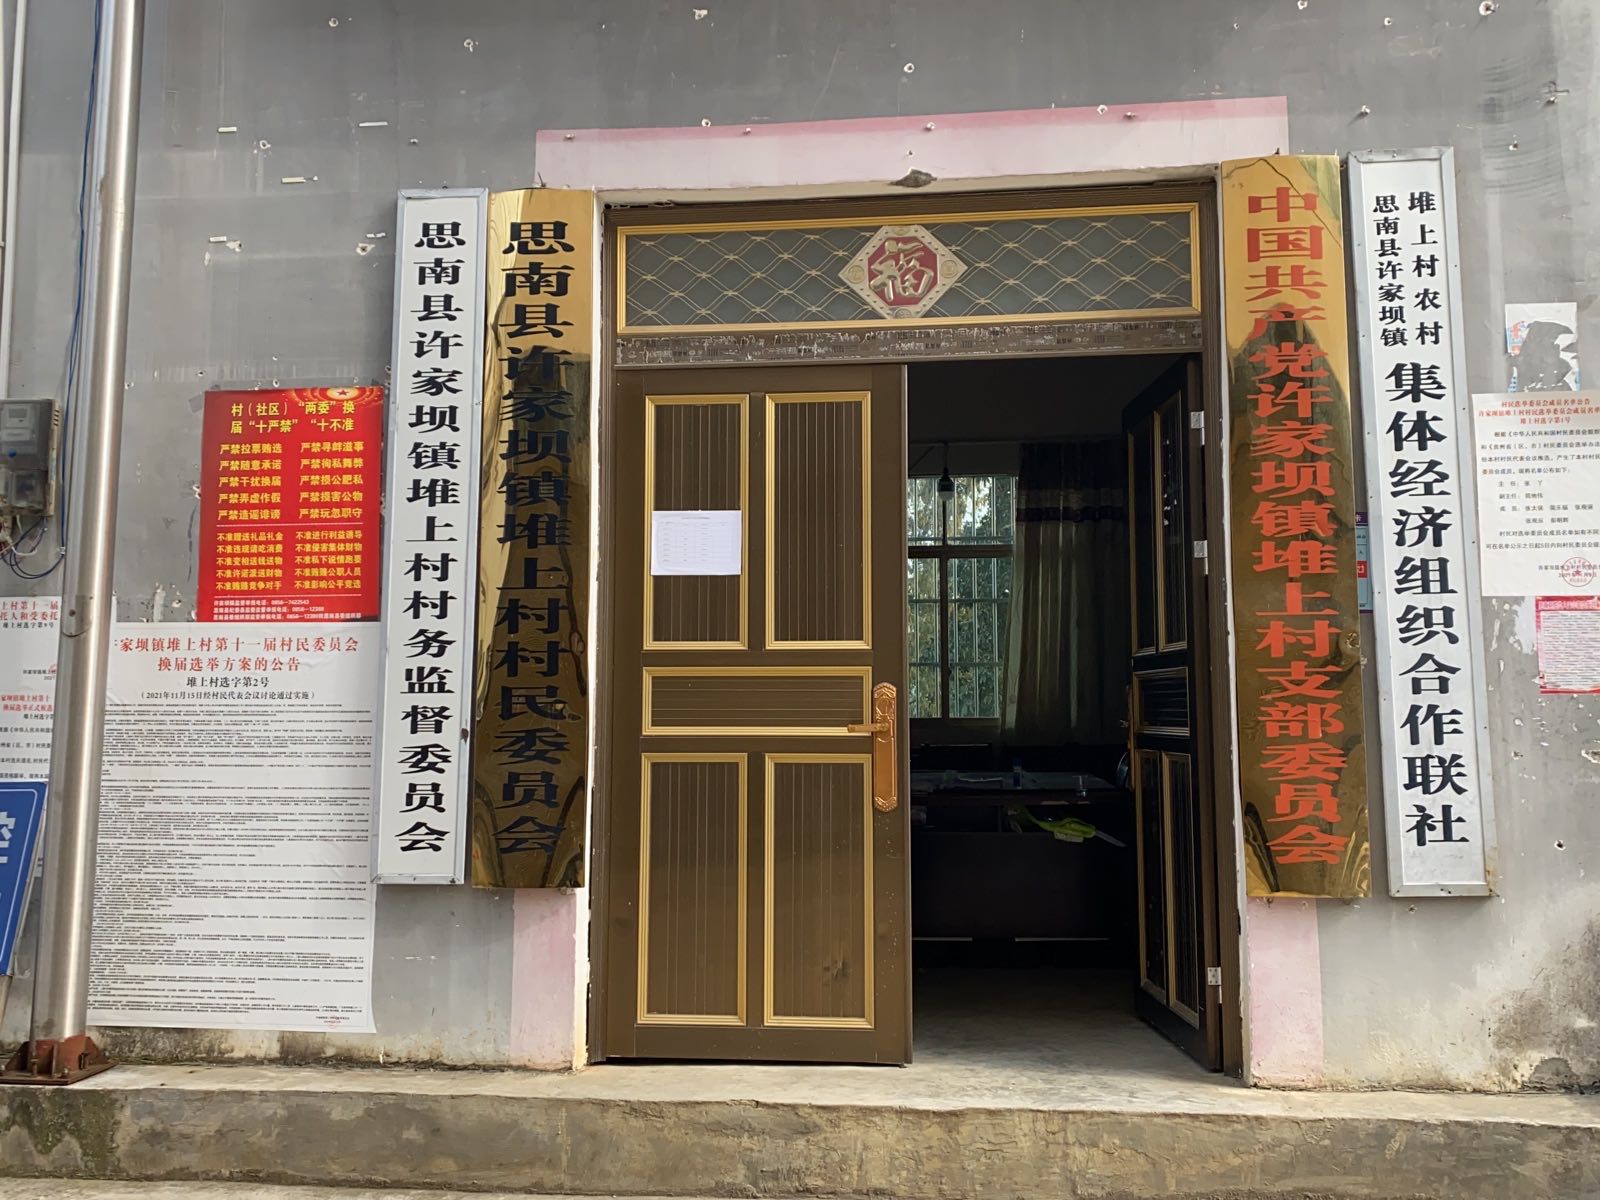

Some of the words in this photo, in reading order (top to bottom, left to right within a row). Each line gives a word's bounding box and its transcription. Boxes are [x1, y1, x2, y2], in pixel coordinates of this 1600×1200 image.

[1372, 195, 1410, 348] 思南县许家坝镇
[1407, 191, 1444, 346] 堆上村农村
[220, 443, 283, 455] 严禁拉票贿选
[300, 441, 365, 453] 严禁寻衅滋事
[219, 459, 282, 471] 严禁随意承诺
[218, 476, 282, 488] 严禁干扰换届
[300, 474, 364, 486] 严禁损公肥私
[218, 492, 282, 504] 严禁弄虚作假
[218, 508, 281, 521] 严禁造谣诽谤
[299, 508, 363, 519] 严禁玩忽职守
[1244, 186, 1349, 865] 中国共产党许家坝镇堆上村支部委员会
[394, 220, 466, 852] 思南县许家坝镇堆上村村务监督委员会
[492, 220, 576, 855] 思南县许家坝镇堆上村村民委员会
[1385, 362, 1471, 847] 集体经济组织合作联社
[113, 636, 359, 653] 家坝镇堆上村第十一届村民委员会
[157, 656, 301, 672] 换届选举方案的公告
[186, 676, 270, 688] 堆上村选字第2号
